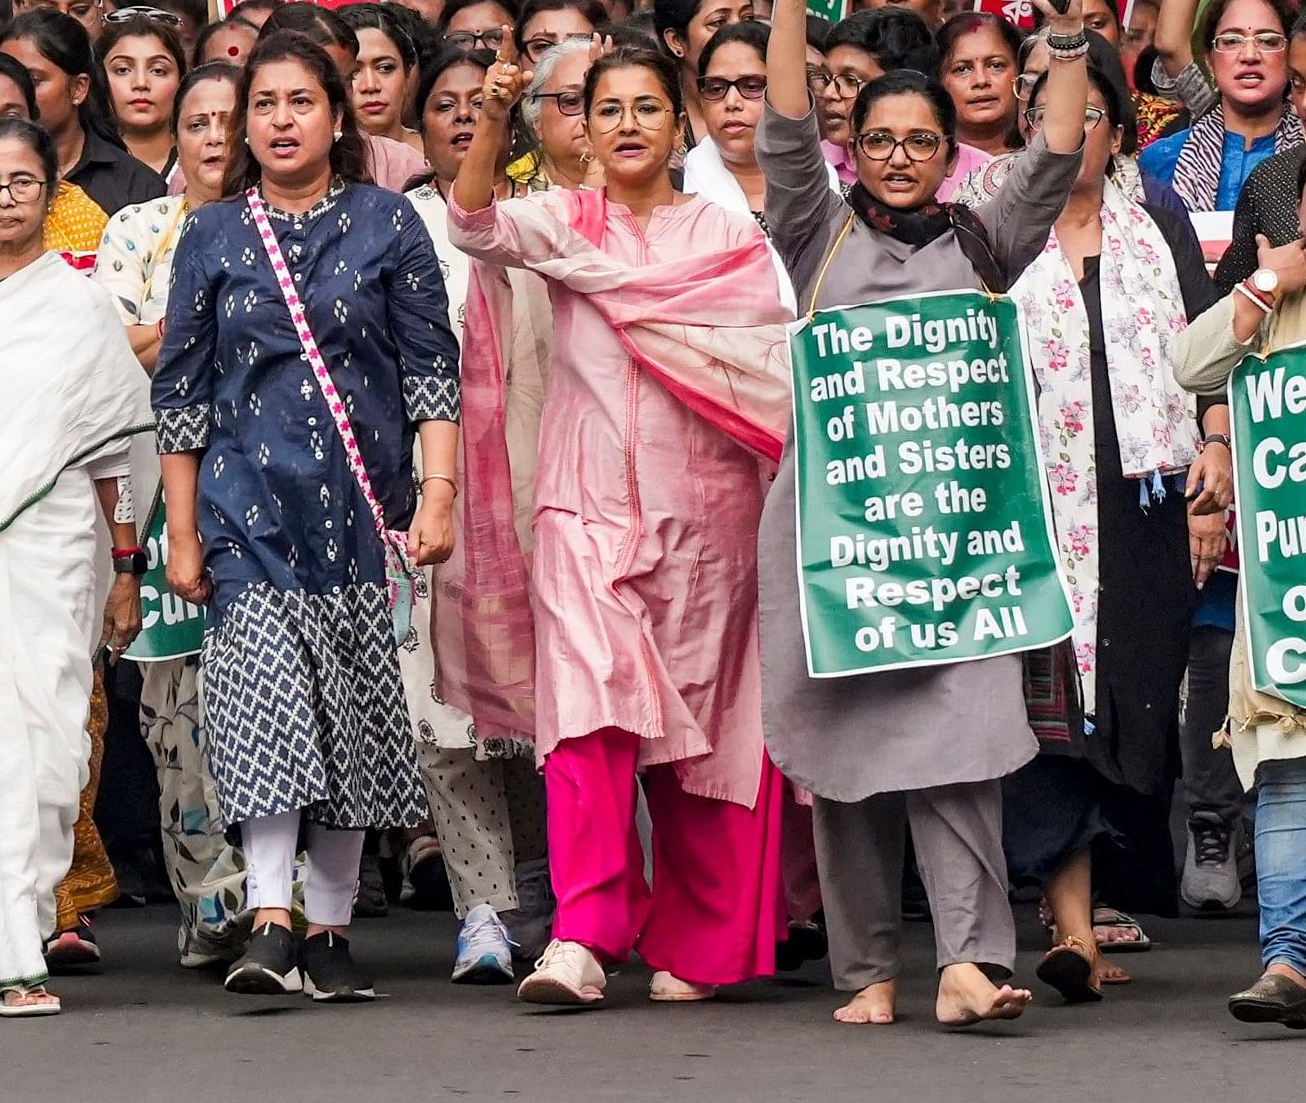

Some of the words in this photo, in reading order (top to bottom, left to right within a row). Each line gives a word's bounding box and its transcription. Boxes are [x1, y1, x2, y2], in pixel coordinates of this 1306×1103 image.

[812, 322, 873, 358] The
[886, 308, 998, 355] Dignity
[810, 360, 864, 402] and
[877, 352, 1009, 394] Respect
[827, 403, 855, 442] of
[866, 397, 1004, 436] Mothers
[826, 445, 886, 486] and
[897, 438, 1011, 475] Sisters
[864, 491, 924, 522] are
[935, 480, 987, 515] the
[829, 529, 960, 573] Dignity
[966, 520, 1025, 556] and
[846, 563, 1022, 612] Respect
[854, 616, 898, 652] of
[910, 621, 959, 649] us
[973, 605, 1028, 642] All
